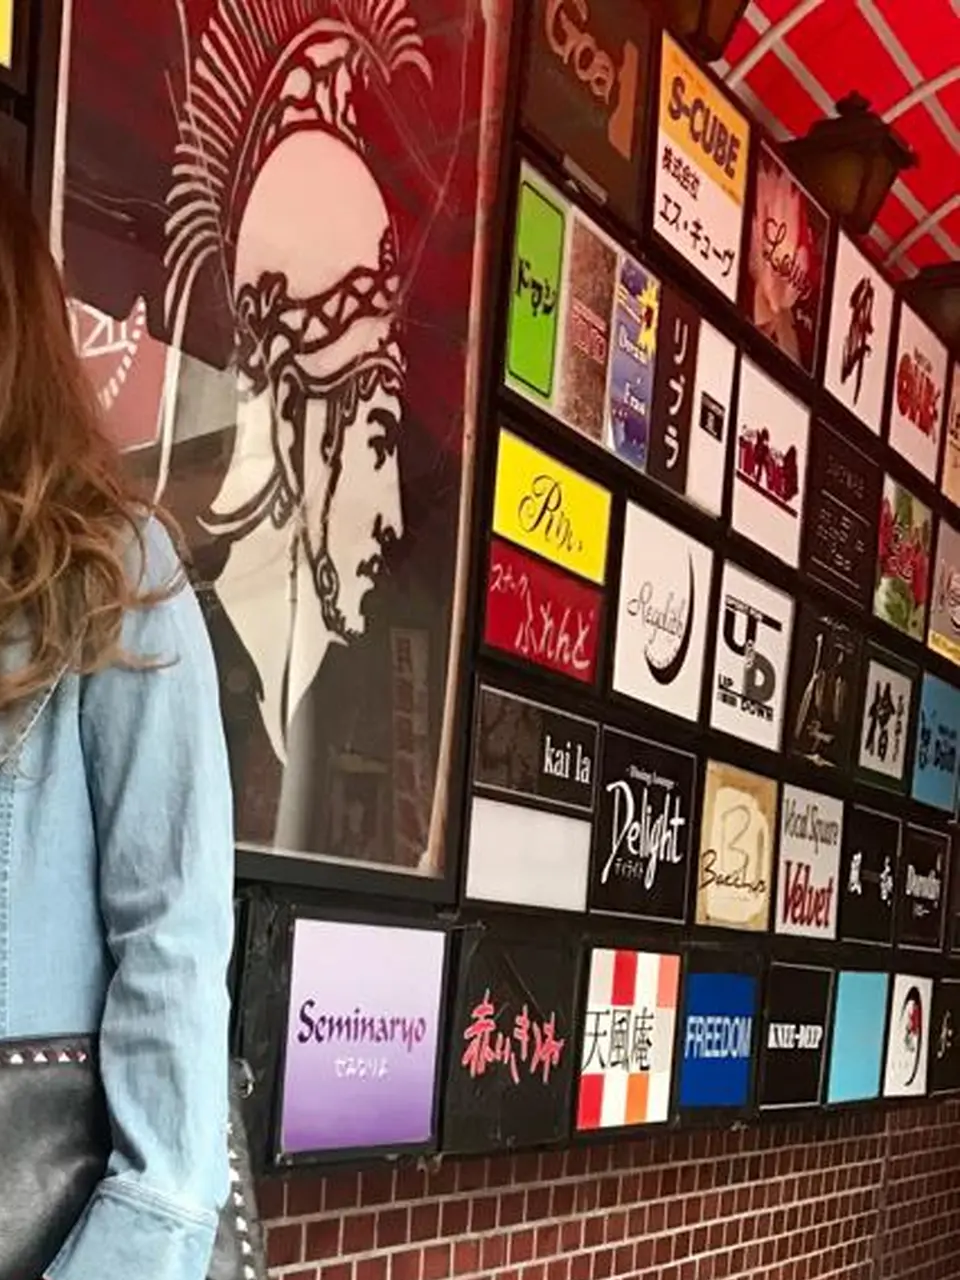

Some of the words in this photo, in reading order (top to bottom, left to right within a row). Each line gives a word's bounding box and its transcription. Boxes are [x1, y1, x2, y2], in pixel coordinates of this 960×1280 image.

[667, 75, 740, 180] S-CUBE
[665, 317, 689, 470] リブラ
[544, 735, 570, 779] kai
[575, 744, 590, 784] la
[601, 780, 686, 889] Delight
[782, 860, 834, 928] Velvet
[297, 998, 427, 1052] Seminaryo
[580, 1006, 655, 1072] 天風庵
[685, 1016, 752, 1059] FREEDOM
